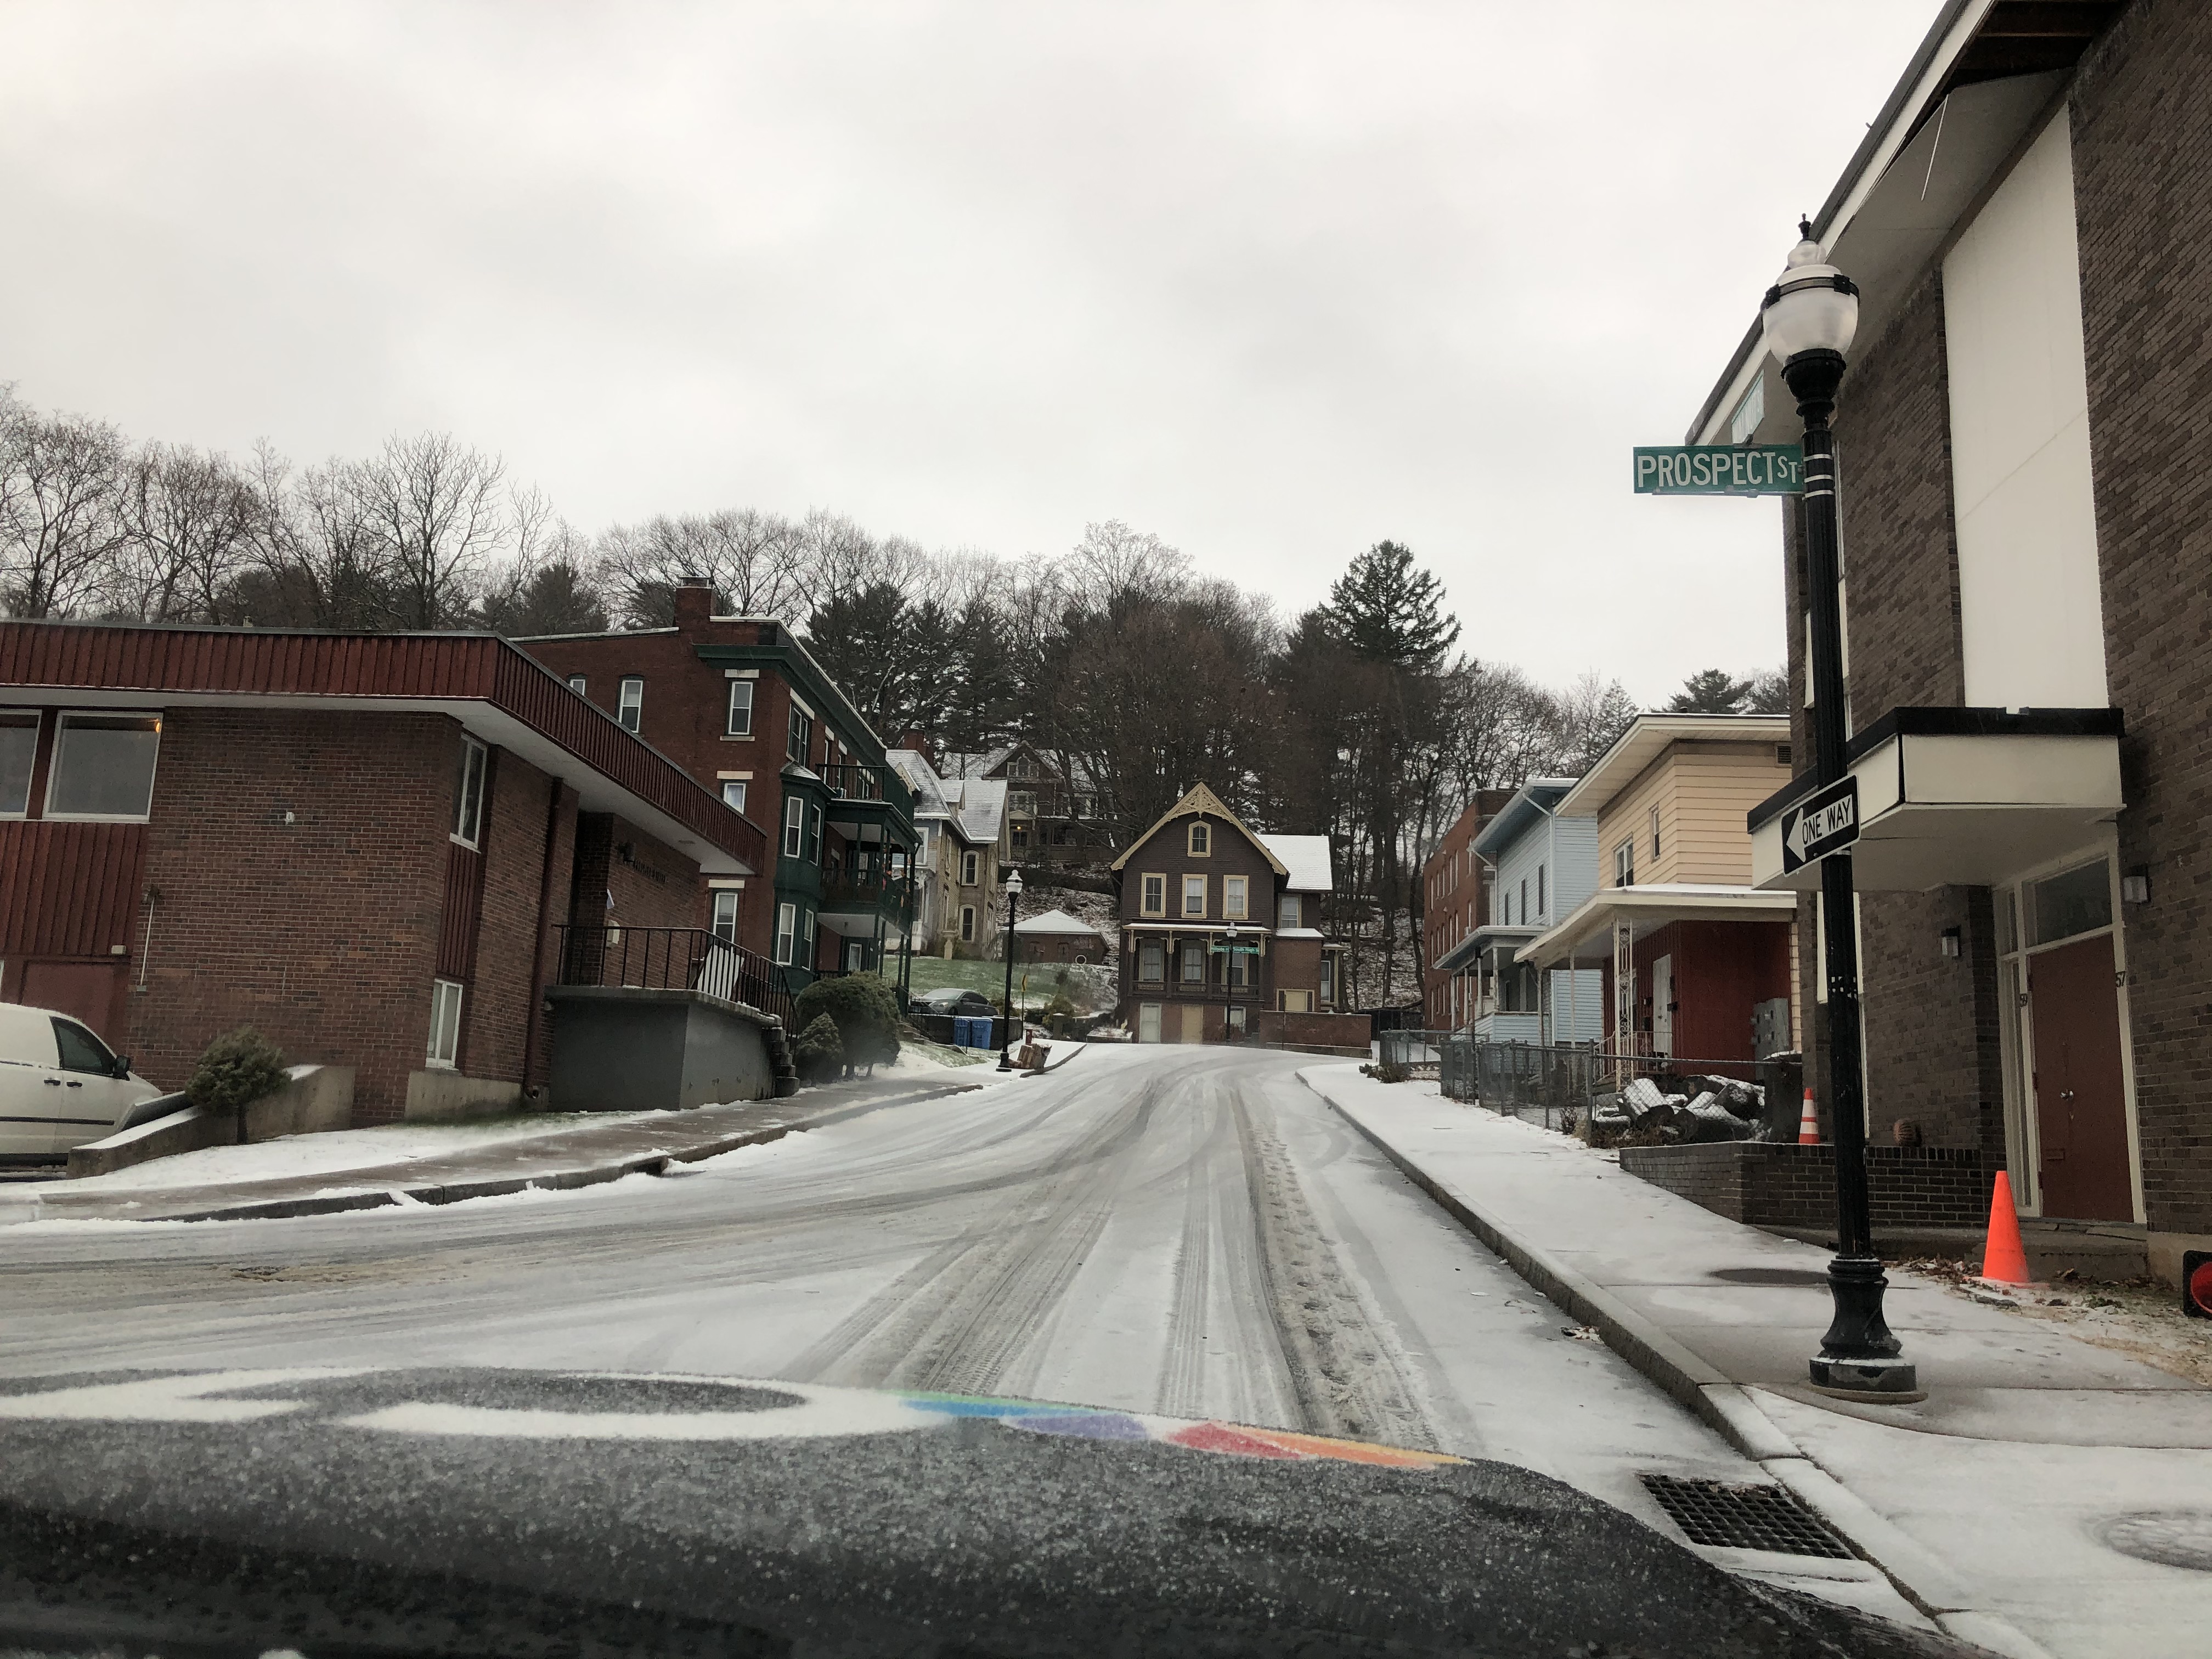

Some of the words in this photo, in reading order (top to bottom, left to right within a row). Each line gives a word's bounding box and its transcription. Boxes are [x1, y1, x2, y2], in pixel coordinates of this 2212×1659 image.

[1638, 452, 1776, 488] PROSPECT
[1777, 456, 1798, 483] ST
[1802, 813, 1822, 845] ONE
[1826, 797, 1850, 832] WAY
[2116, 971, 2126, 987] 57
[2019, 994, 2028, 1007] 59
